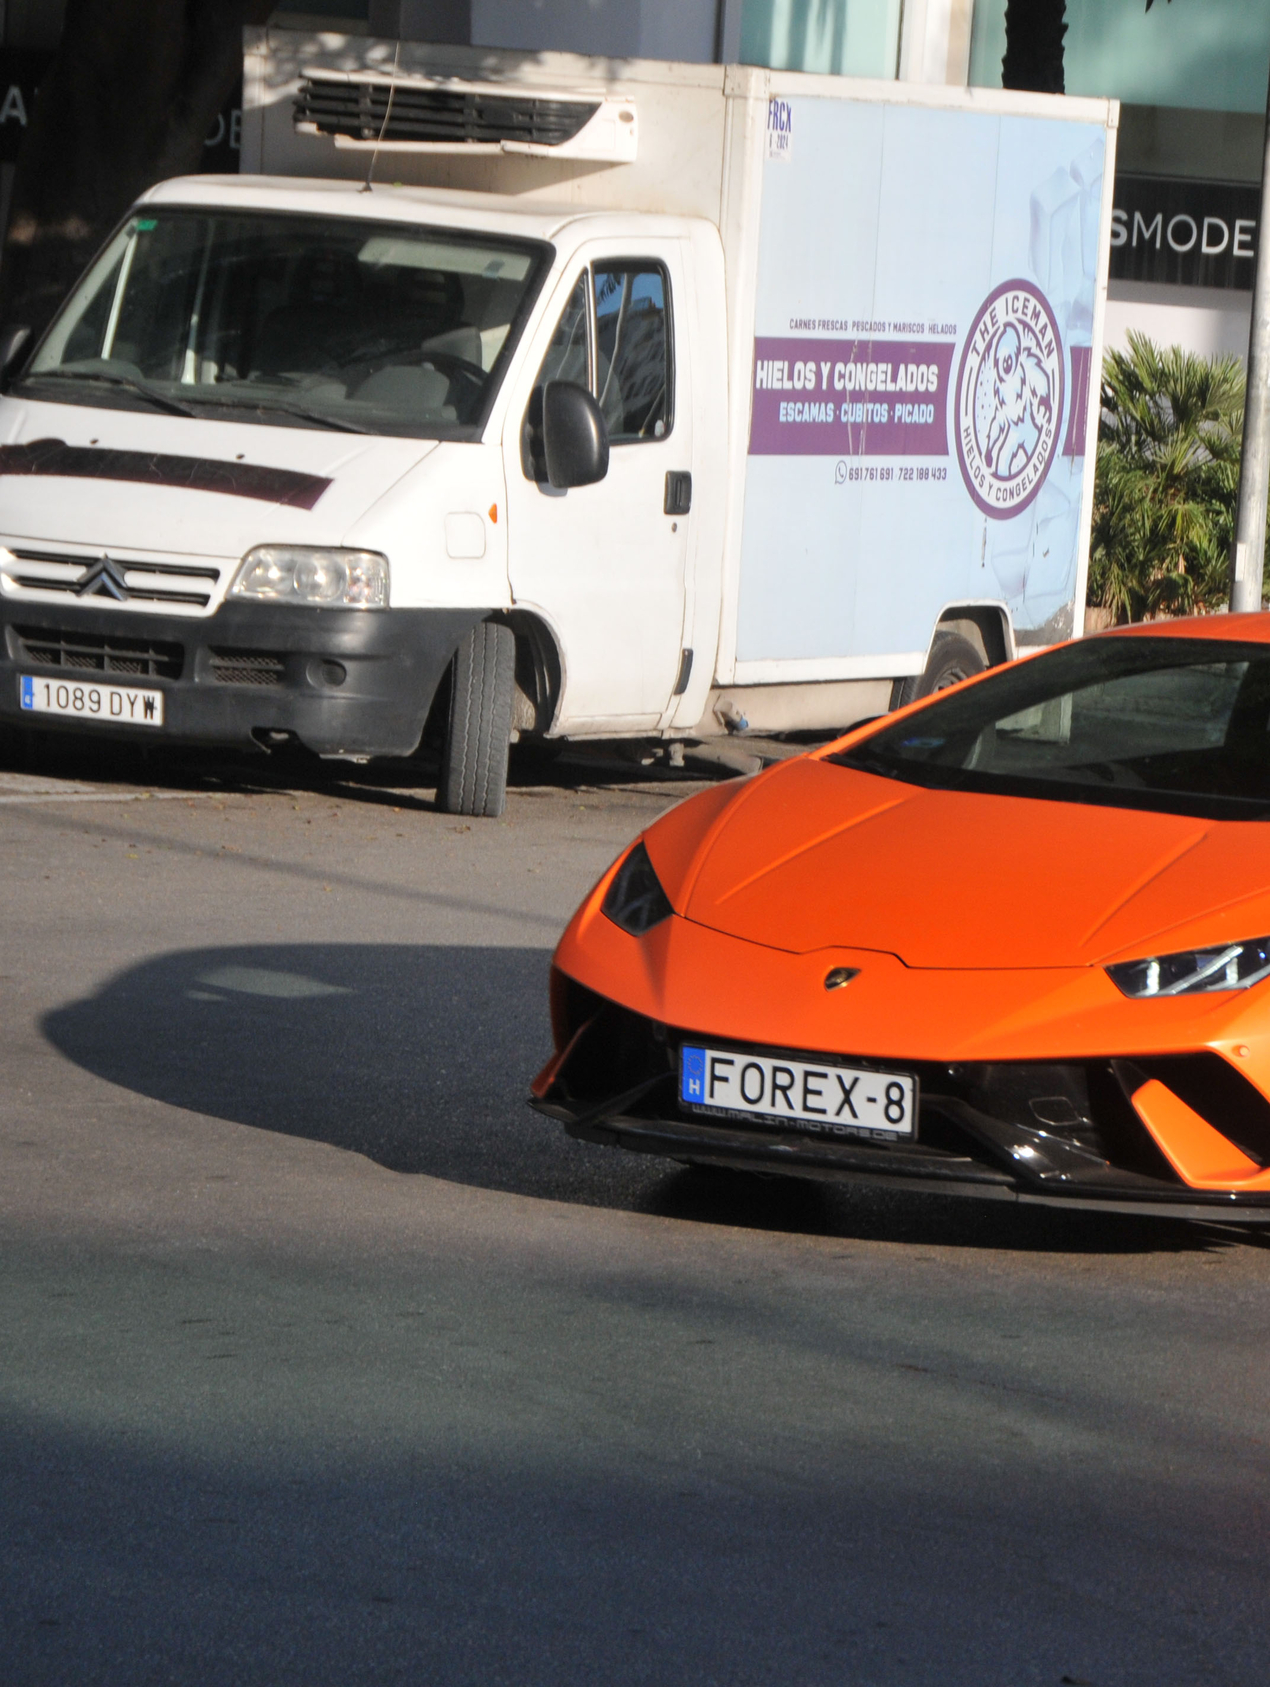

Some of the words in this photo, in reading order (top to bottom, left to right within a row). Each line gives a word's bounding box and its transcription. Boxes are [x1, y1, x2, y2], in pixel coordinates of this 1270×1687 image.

[767, 98, 792, 133] FRCX
[789, 318, 816, 330] CARNES
[818, 319, 848, 332] FRESCAS
[852, 320, 886, 333] PESCADOS
[887, 322, 892, 333] Y
[893, 322, 925, 334] MARISCOS
[928, 323, 957, 335] HELADOS
[971, 306, 998, 357] THE
[1005, 295, 1054, 359] ICEMAN
[755, 360, 816, 390] HIELOS
[820, 361, 831, 390] Y
[834, 362, 939, 392] CONGELADOS
[779, 402, 834, 423] ESCAMAS
[841, 403, 888, 423] CUBITOS
[894, 404, 934, 424] PICADO
[849, 467, 863, 480] 691
[864, 467, 878, 480] 761
[880, 467, 893, 480] 691
[898, 467, 914, 480] 722
[916, 467, 929, 480] 188
[931, 467, 947, 481] 433
[963, 425, 985, 488] HIELOS
[987, 481, 993, 497] Y
[995, 427, 1052, 502] CONGELADOS
[44, 683, 101, 713] 1089
[110, 691, 156, 720] DYW
[688, 1077, 700, 1096] H
[709, 1056, 905, 1125] FOREX-8
